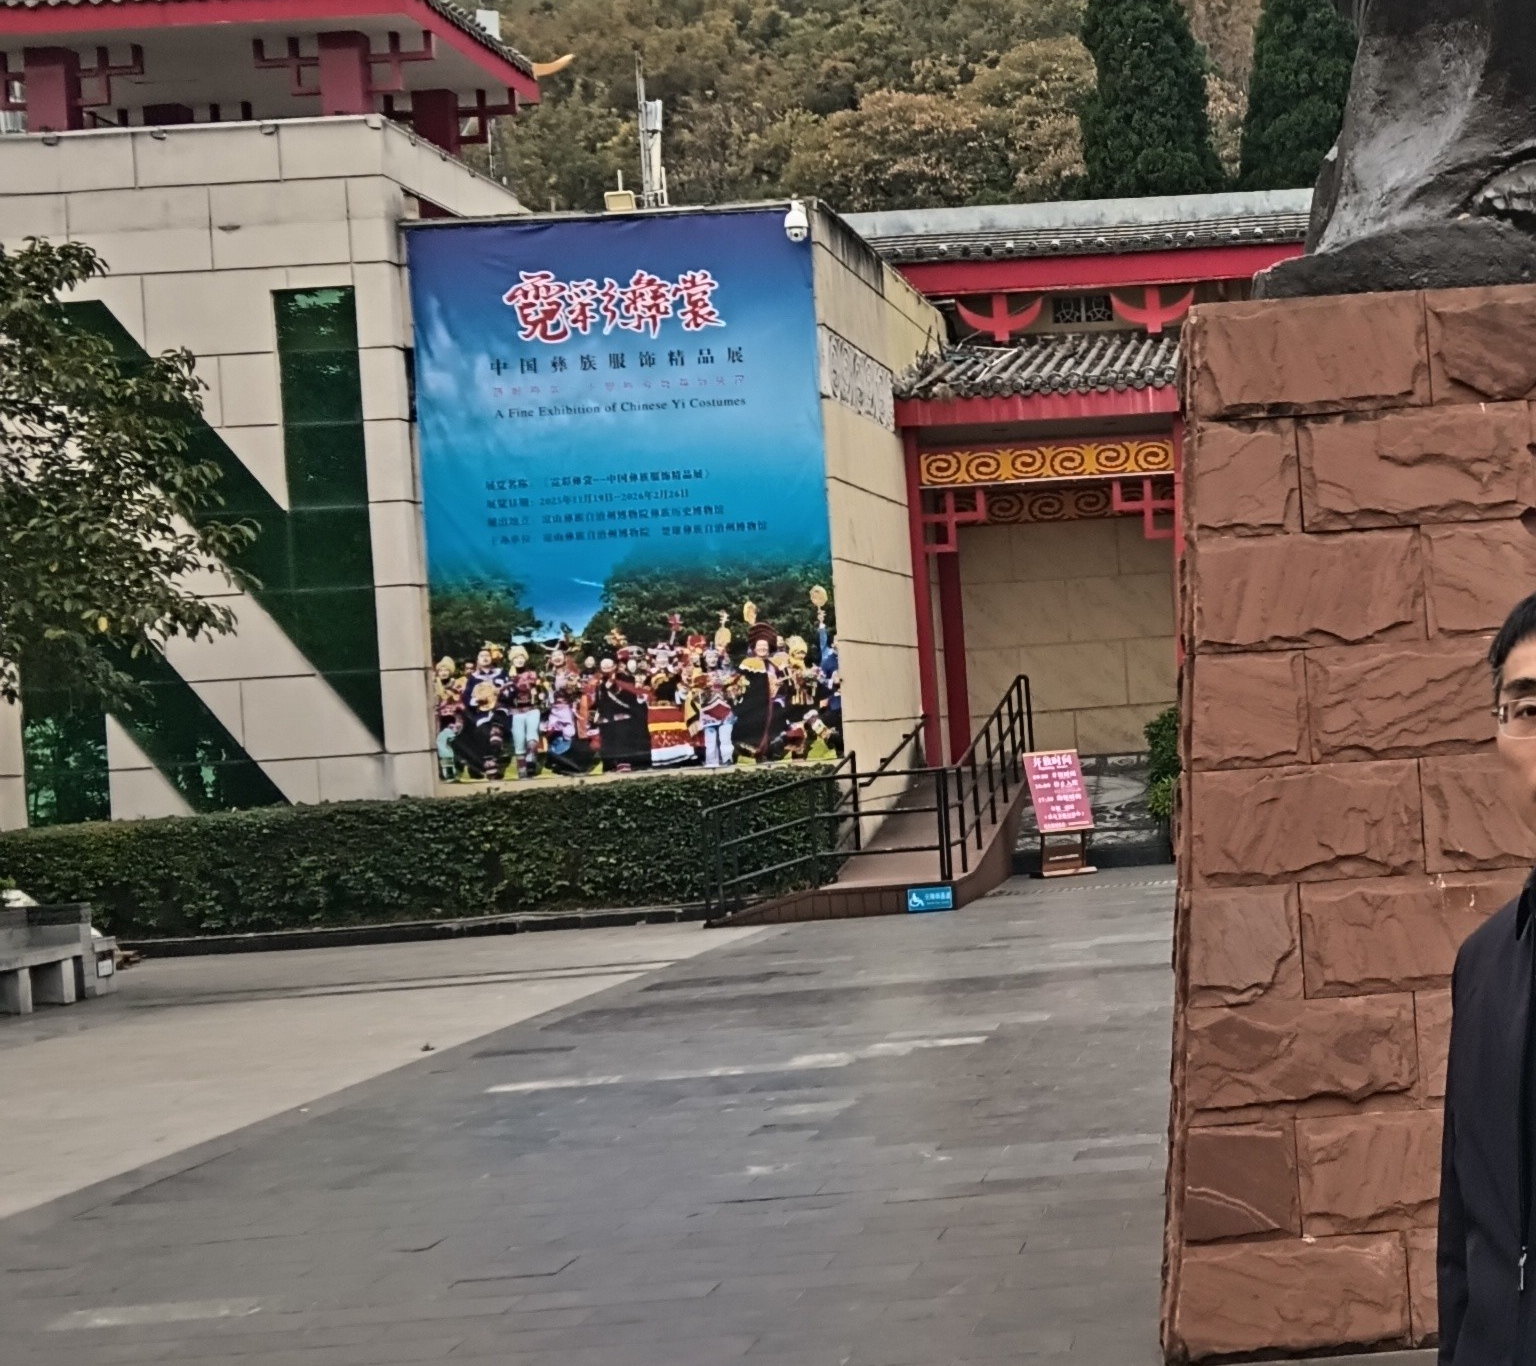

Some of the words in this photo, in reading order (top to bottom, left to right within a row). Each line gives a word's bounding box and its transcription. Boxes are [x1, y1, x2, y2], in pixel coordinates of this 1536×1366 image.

[503, 269, 727, 344] 霓彩彝裳
[490, 346, 744, 376] 中国彝族服饰精品展
[495, 409, 504, 419] A
[509, 408, 534, 418] Fine
[538, 404, 600, 417] Exhibition
[604, 402, 617, 413] of
[620, 401, 668, 412] Chinese
[671, 398, 686, 410] Yi
[690, 397, 746, 409] Costumes
